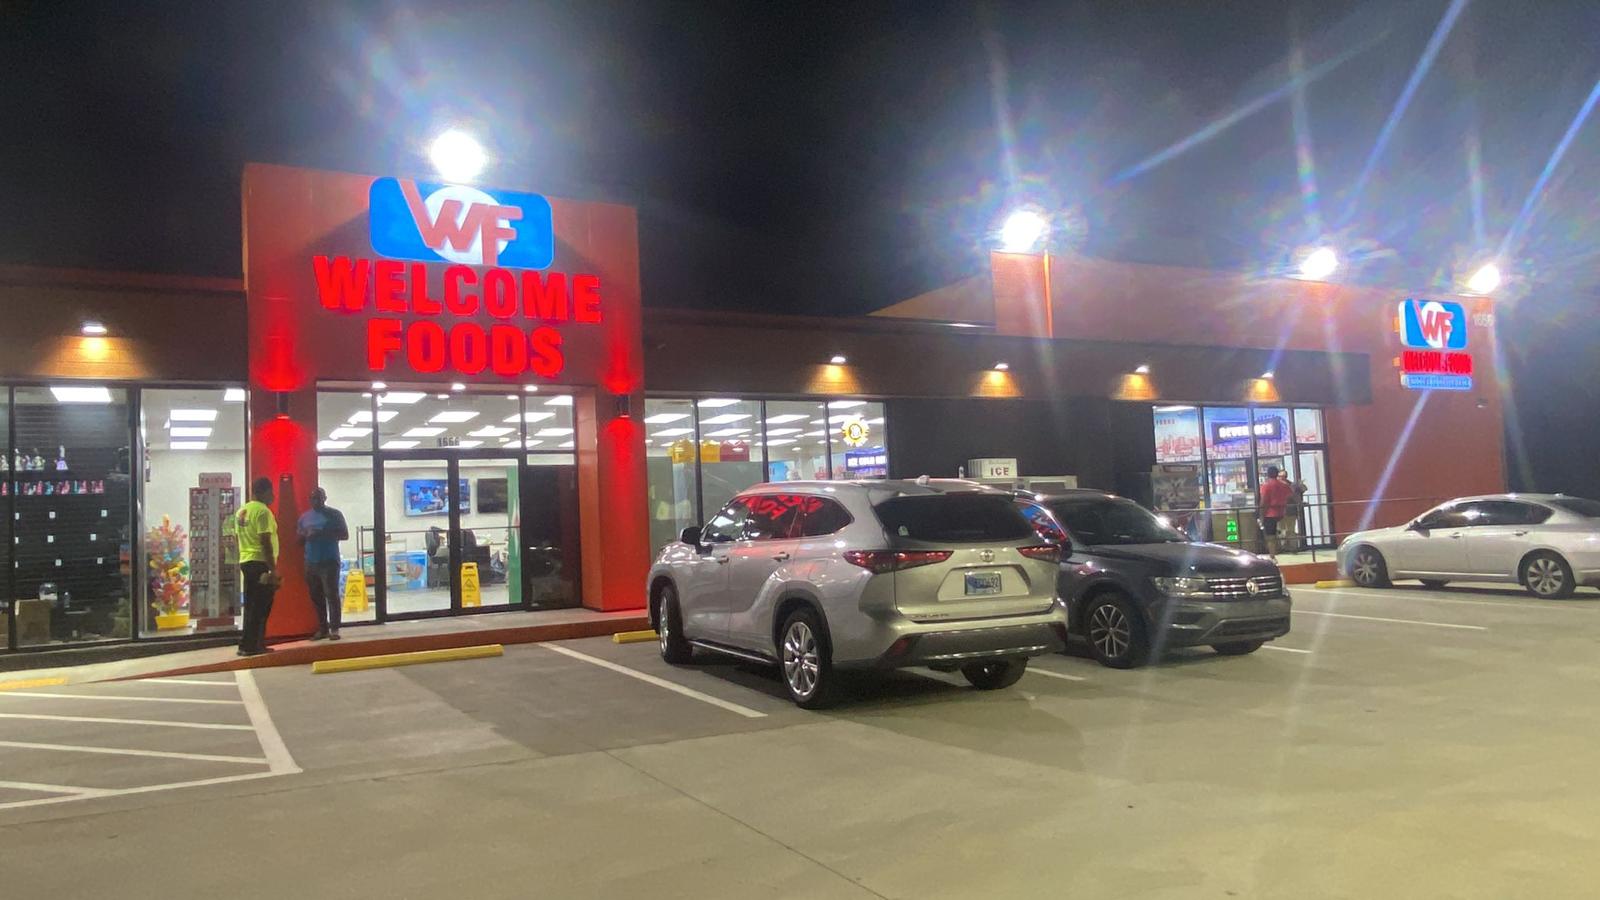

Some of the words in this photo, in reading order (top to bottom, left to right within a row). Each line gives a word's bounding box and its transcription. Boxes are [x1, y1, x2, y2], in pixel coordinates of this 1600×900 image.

[399, 177, 523, 266] WF
[313, 255, 602, 323] WELCOME
[367, 317, 565, 377] FOODS
[1412, 299, 1454, 348] WF
[1219, 423, 1273, 438] BEVERGES
[990, 467, 1009, 476] ICE
